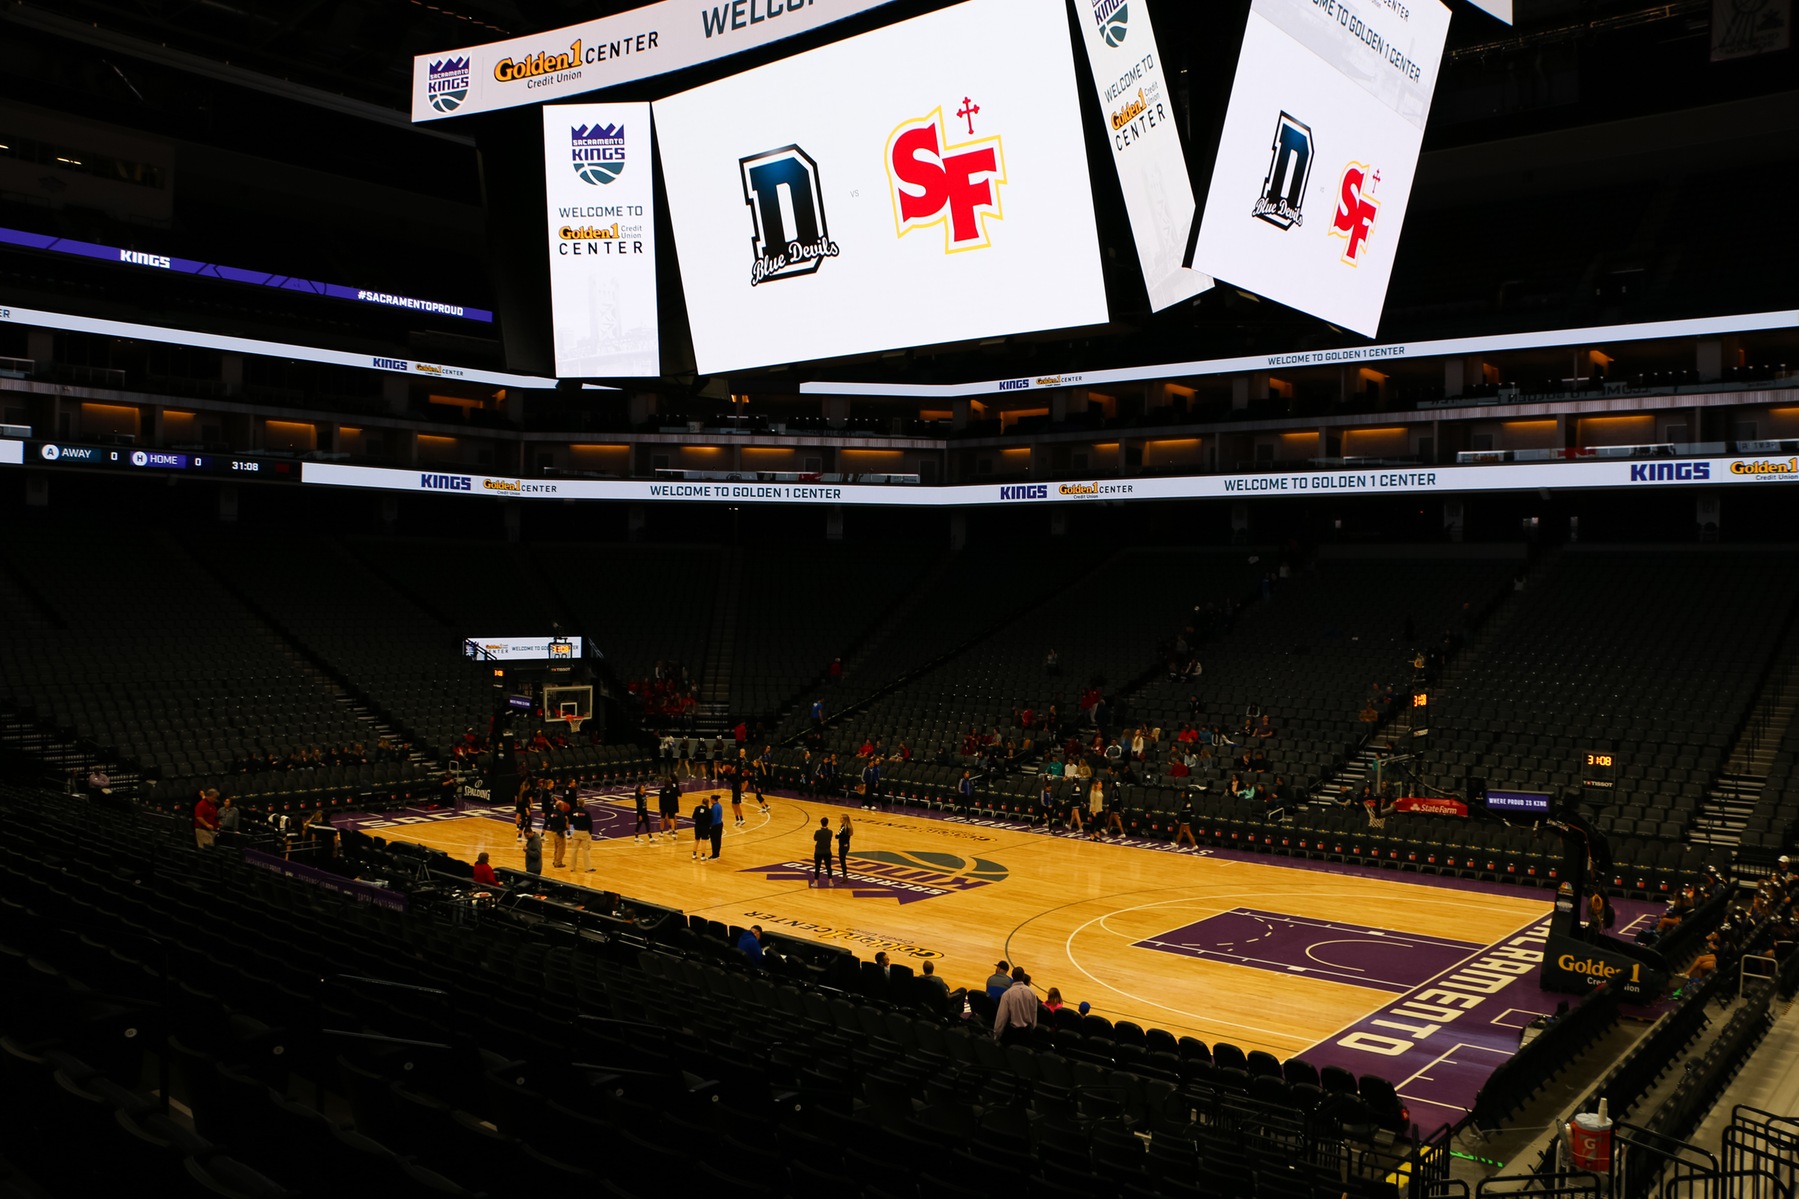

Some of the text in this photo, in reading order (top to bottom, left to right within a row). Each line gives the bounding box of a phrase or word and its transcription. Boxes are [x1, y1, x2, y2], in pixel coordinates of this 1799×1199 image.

[585, 31, 659, 65] CENTER
[1336, 4, 1349, 26] TO
[1349, 15, 1385, 55] GOLDEN
[1385, 44, 1390, 59] 1
[1389, 48, 1421, 83] CENTER
[430, 68, 469, 80] SACRAMENTO
[527, 70, 582, 89] Credit Union
[1104, 54, 1154, 103] WELCOME TO
[428, 76, 469, 94] KINGS
[1116, 103, 1166, 151] CENTER
[573, 138, 624, 146] SACRAMENTO
[572, 147, 625, 161] KINGS
[559, 205, 643, 218] WELCOME TO
[1252, 197, 1303, 227] Blue Devils
[559, 241, 643, 255] CENTER
[120, 250, 170, 268] KINGS
[752, 236, 839, 287] Blue Devils
[358, 291, 463, 316] #SACRAMENTOPROUD
[373, 358, 407, 370] KINGS
[1268, 346, 1405, 365] WELCOME TO GOLDEN 1 CENTER
[999, 379, 1029, 390] KINGS
[61, 447, 91, 458] AWAY
[110, 452, 117, 461] 0
[150, 454, 178, 465] HOME
[195, 458, 201, 466] 0
[232, 461, 259, 471] 31:08
[1631, 462, 1710, 481] KINGS
[421, 474, 471, 491] KINGS
[521, 484, 557, 493] CENTER
[1224, 473, 1436, 491] WELCOME TO GOLDEN 1 CENTER
[650, 485, 841, 499] WELCOME TO GOLDEN 1 CENTER
[1000, 485, 1047, 500] KINGS
[1099, 485, 1133, 494] CENTER
[1587, 754, 1612, 767] 31:08
[464, 785, 491, 801] SPALDING
[1488, 797, 1506, 805] WHERE
[1507, 798, 1524, 806] PROUD
[744, 911, 833, 934] CENTER
[1584, 1138, 1596, 1150] G
